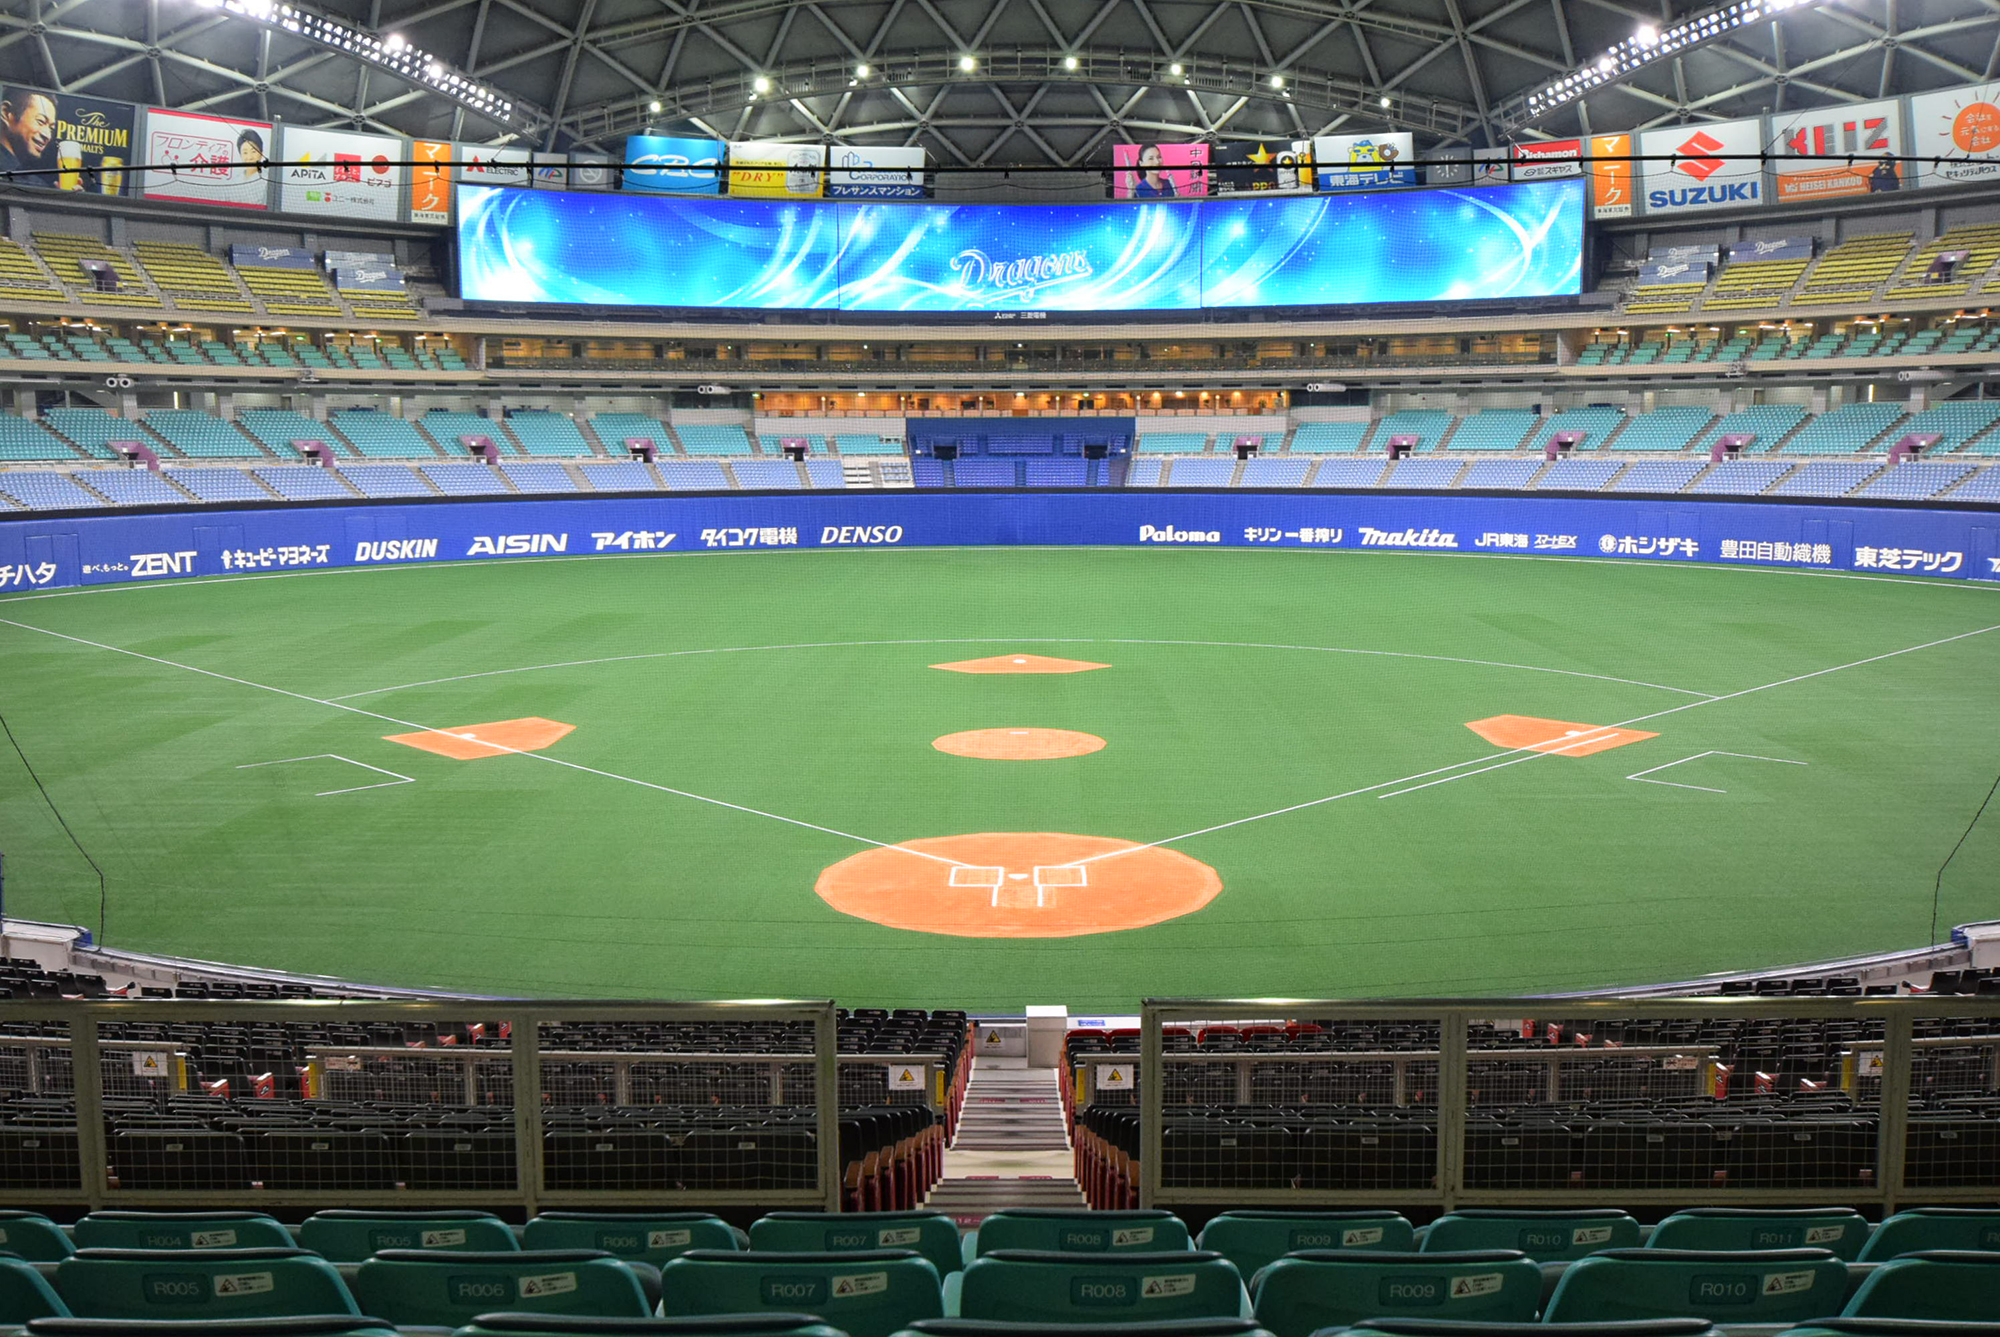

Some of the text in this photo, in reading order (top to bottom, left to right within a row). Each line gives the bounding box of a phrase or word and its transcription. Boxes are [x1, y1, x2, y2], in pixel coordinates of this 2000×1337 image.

[75, 108, 111, 127] The
[57, 120, 128, 148] PREMIUM
[156, 135, 228, 155] フロンティアの
[190, 153, 229, 176] 介護
[486, 167, 518, 176] ELECTRIC
[630, 154, 717, 178] CBC
[1330, 172, 1404, 188] 東海テレビ
[833, 186, 920, 196] プレサンスマンション
[1649, 182, 1759, 208] SUZUKI
[951, 249, 1093, 302] Dragons
[591, 531, 676, 550] アイホン
[700, 527, 798, 547] ダイコク電機
[820, 525, 903, 544] DENSO
[1139, 525, 1220, 542] Paloma
[1358, 527, 1459, 548] Makita
[1474, 532, 1528, 548] JR東海
[466, 533, 568, 555] AISIN
[1618, 536, 1699, 557] ホシザキ
[1720, 539, 1831, 564] 豊田自動織機
[130, 551, 197, 576] ZENT
[1854, 547, 1963, 572] 東芝テック
[147, 1235, 181, 1246] R004
[603, 1235, 637, 1247] R006
[833, 1234, 867, 1247] R007
[1067, 1233, 1101, 1244] R008
[1297, 1233, 1331, 1245] R009
[1526, 1233, 1561, 1245] R010
[1759, 1232, 1793, 1244] R011
[154, 1281, 199, 1296] R005
[459, 1283, 504, 1297] R006
[771, 1284, 816, 1297] R007
[1081, 1284, 1126, 1298] R008
[1389, 1284, 1435, 1297] R009
[1701, 1282, 1746, 1297] R010
